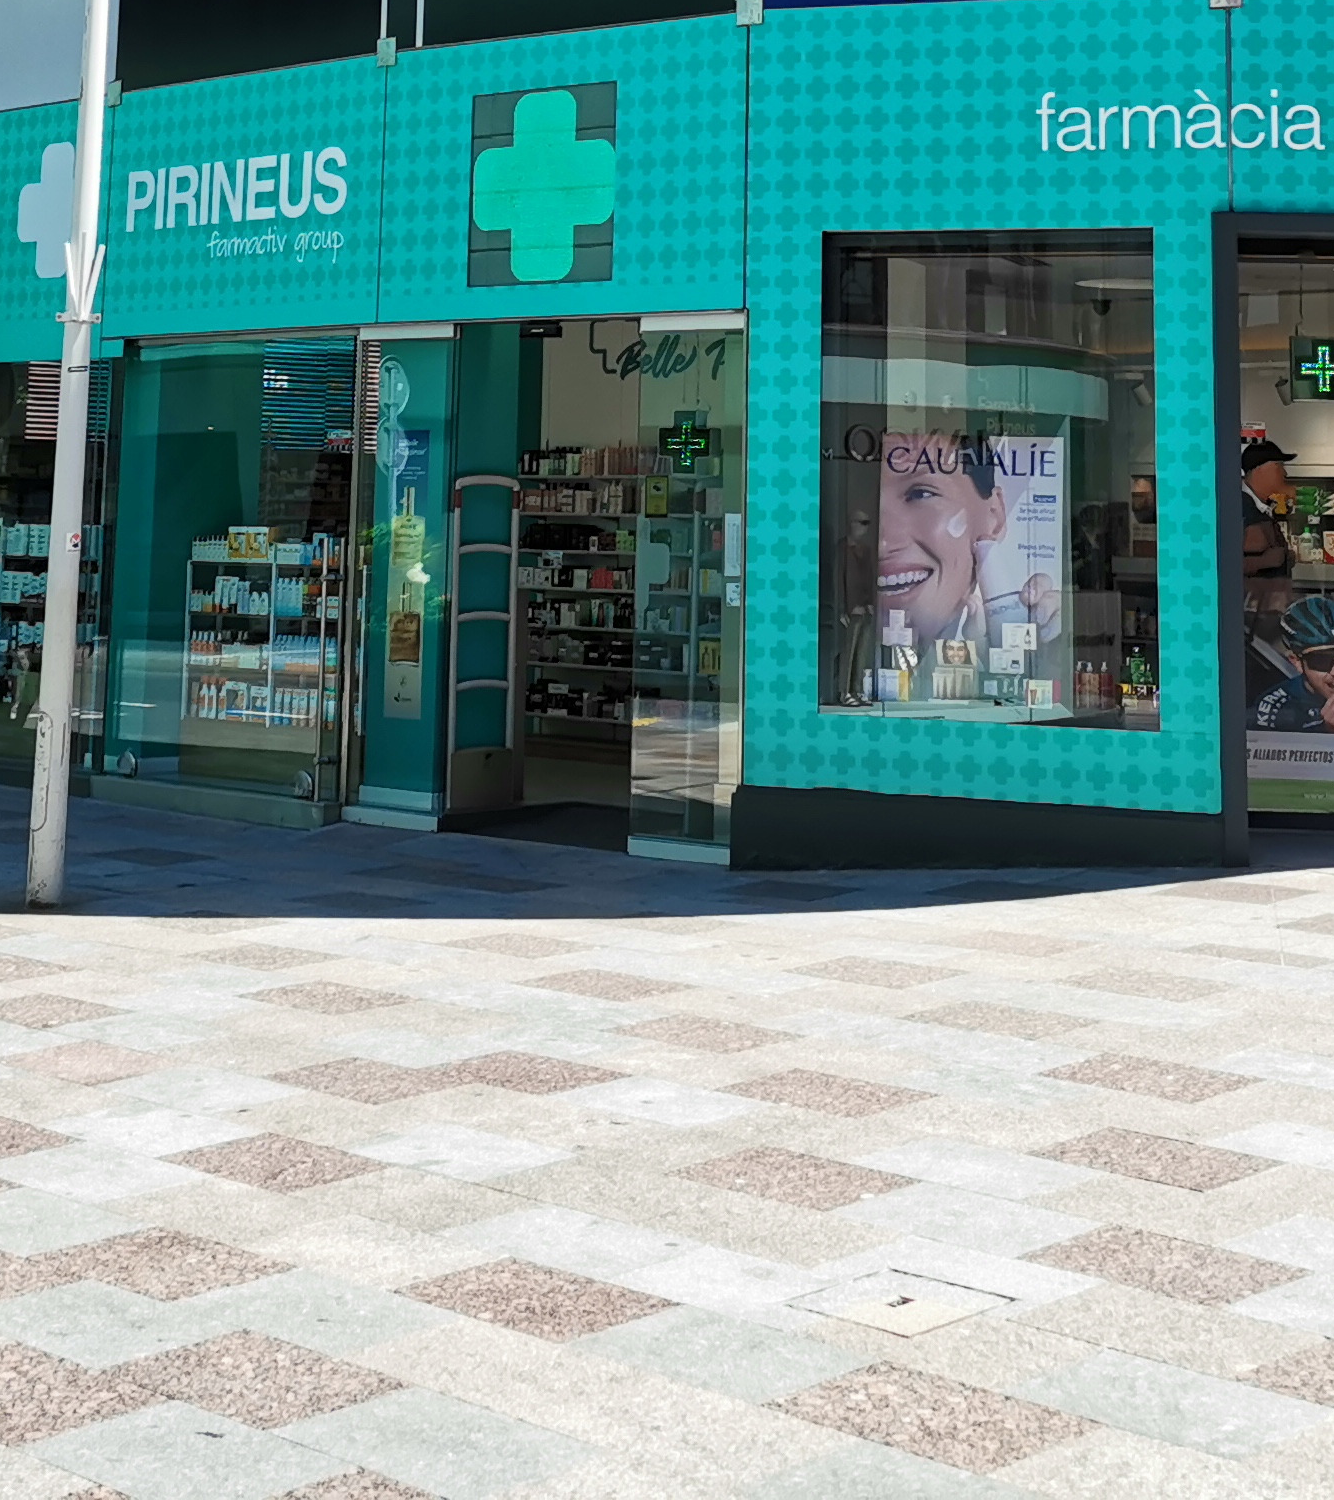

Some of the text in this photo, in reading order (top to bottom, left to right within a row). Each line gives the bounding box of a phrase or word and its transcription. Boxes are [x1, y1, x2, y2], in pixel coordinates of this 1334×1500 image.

[1037, 88, 1325, 151] farmàcia
[126, 147, 347, 232] PIRINEUS
[207, 229, 344, 263] farmactiv group
[617, 334, 697, 380] Belle
[1253, 749, 1286, 761] ALIADOS
[1288, 751, 1334, 764] PERFECTOS
